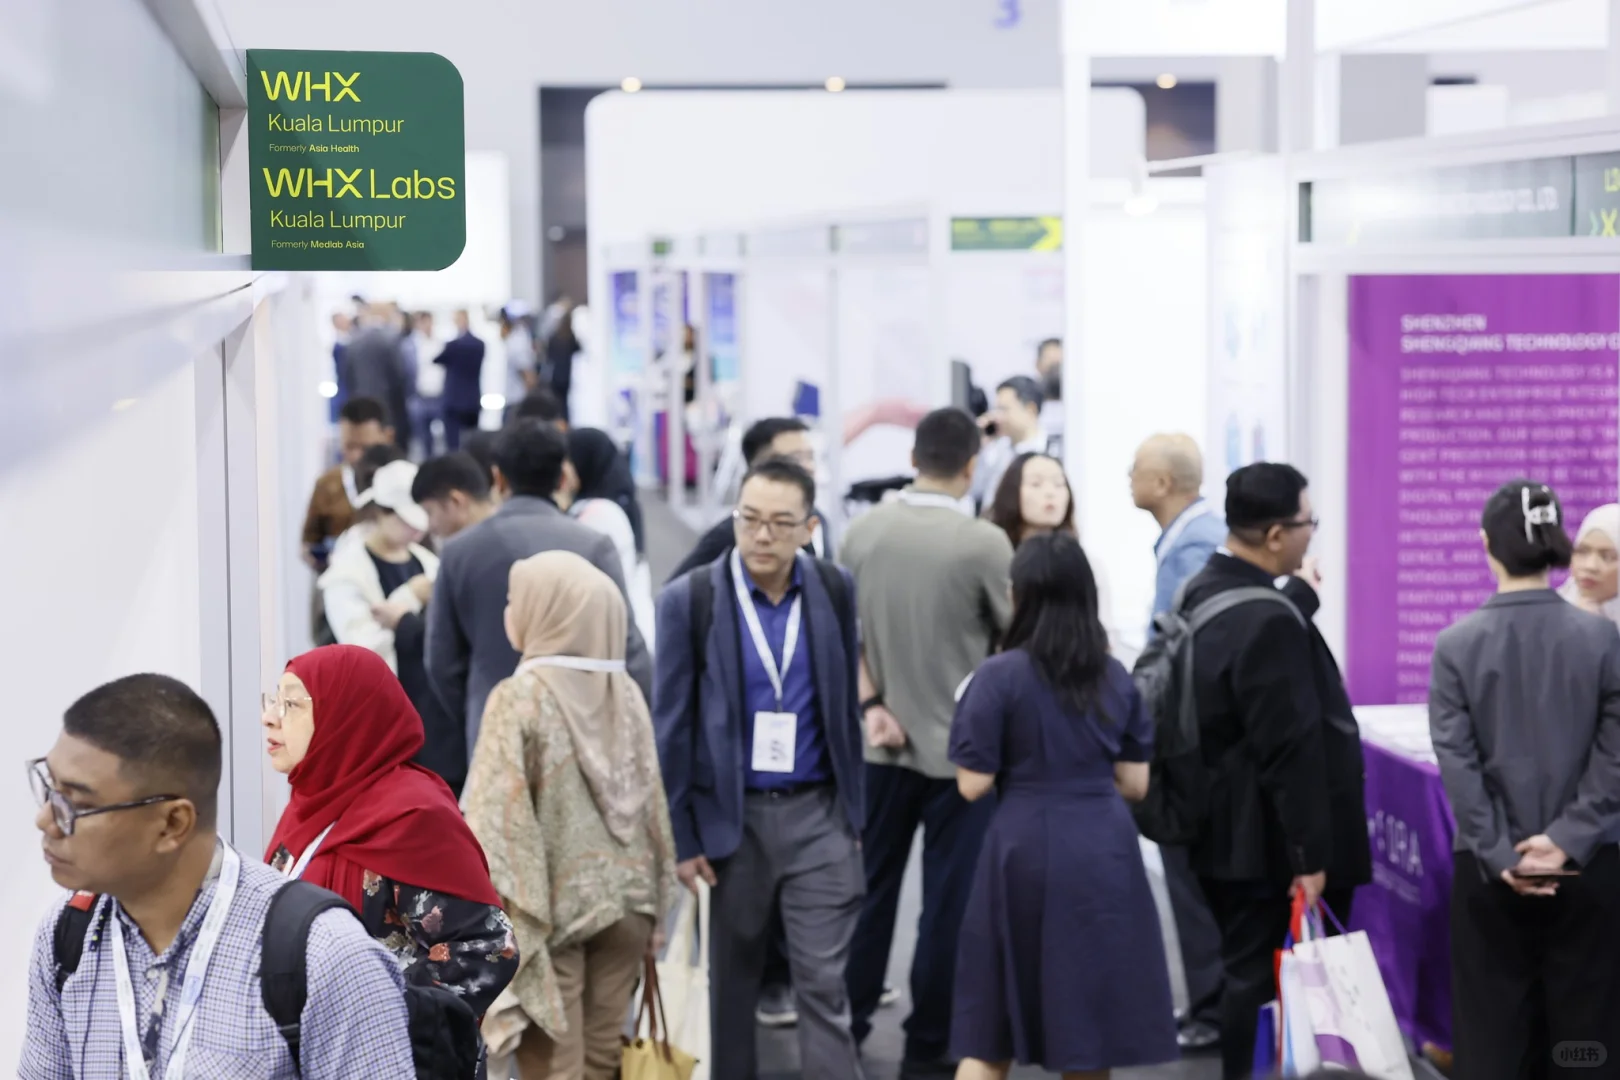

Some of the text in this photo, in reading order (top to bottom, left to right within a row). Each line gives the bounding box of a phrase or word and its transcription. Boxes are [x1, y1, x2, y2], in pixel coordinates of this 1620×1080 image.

[260, 70, 361, 102] WHX
[268, 113, 404, 136] Kuala Lumpur
[269, 144, 359, 154] Formerly Asia Health
[262, 168, 456, 199] WHX Labs
[270, 210, 406, 231] Kuala Lumpur
[271, 240, 365, 250] Formerly Medlab Asia
[1401, 314, 1487, 332] SHENZHEN
[1506, 333, 1606, 352] TECHNOLOGY
